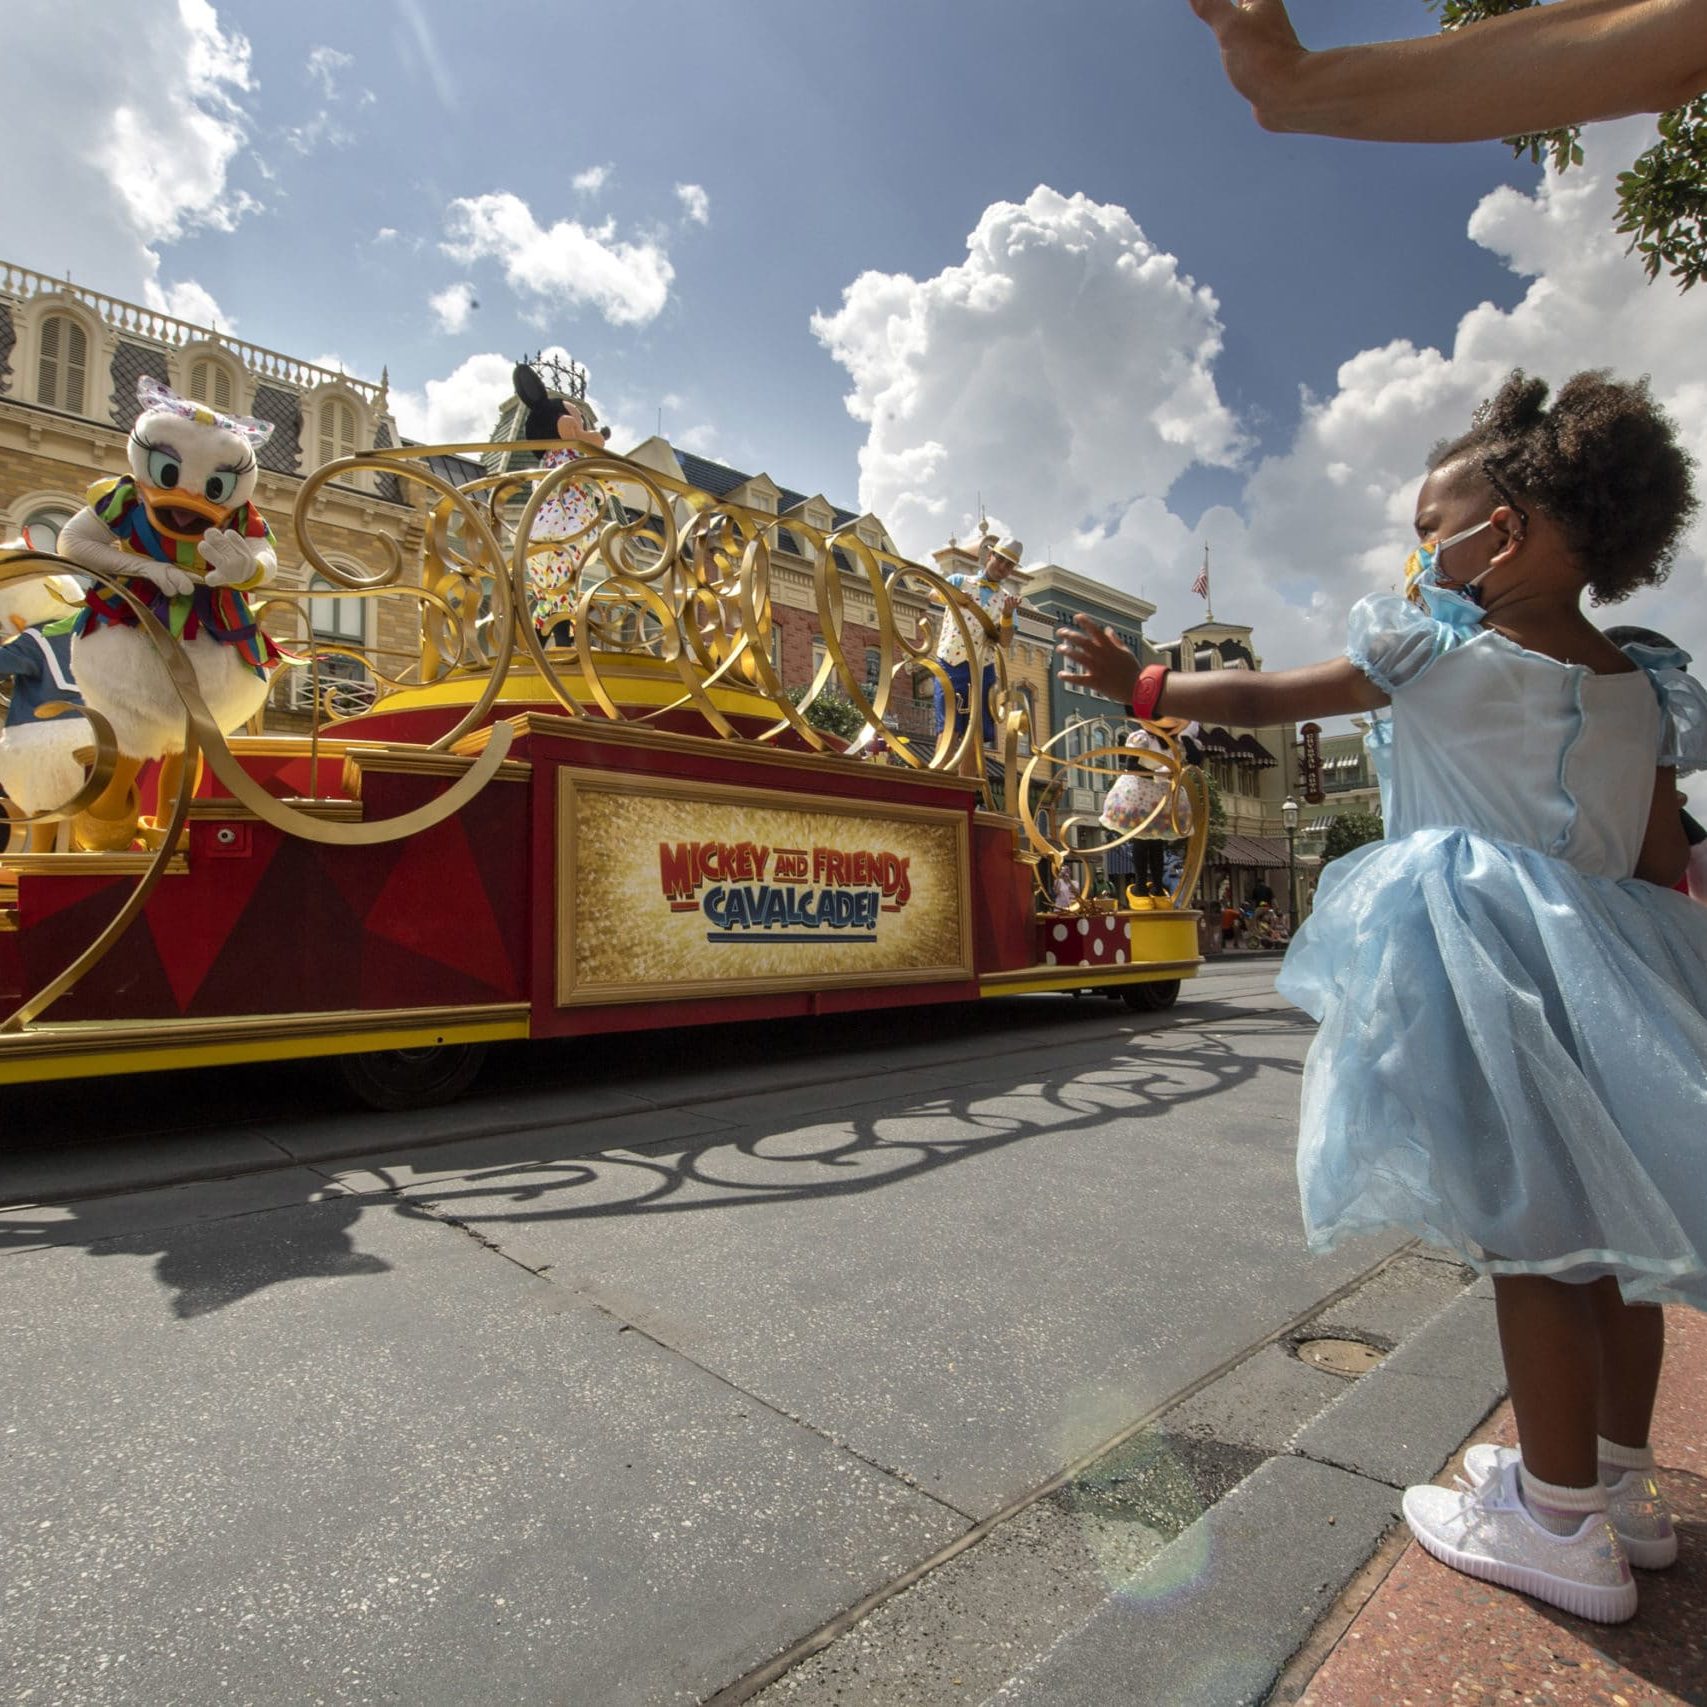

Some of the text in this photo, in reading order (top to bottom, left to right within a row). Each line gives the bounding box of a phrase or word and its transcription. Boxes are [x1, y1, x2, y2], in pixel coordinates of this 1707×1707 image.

[659, 841, 911, 906] MICKEY AND FRIENDS
[703, 885, 879, 930] CAVALCADE!
